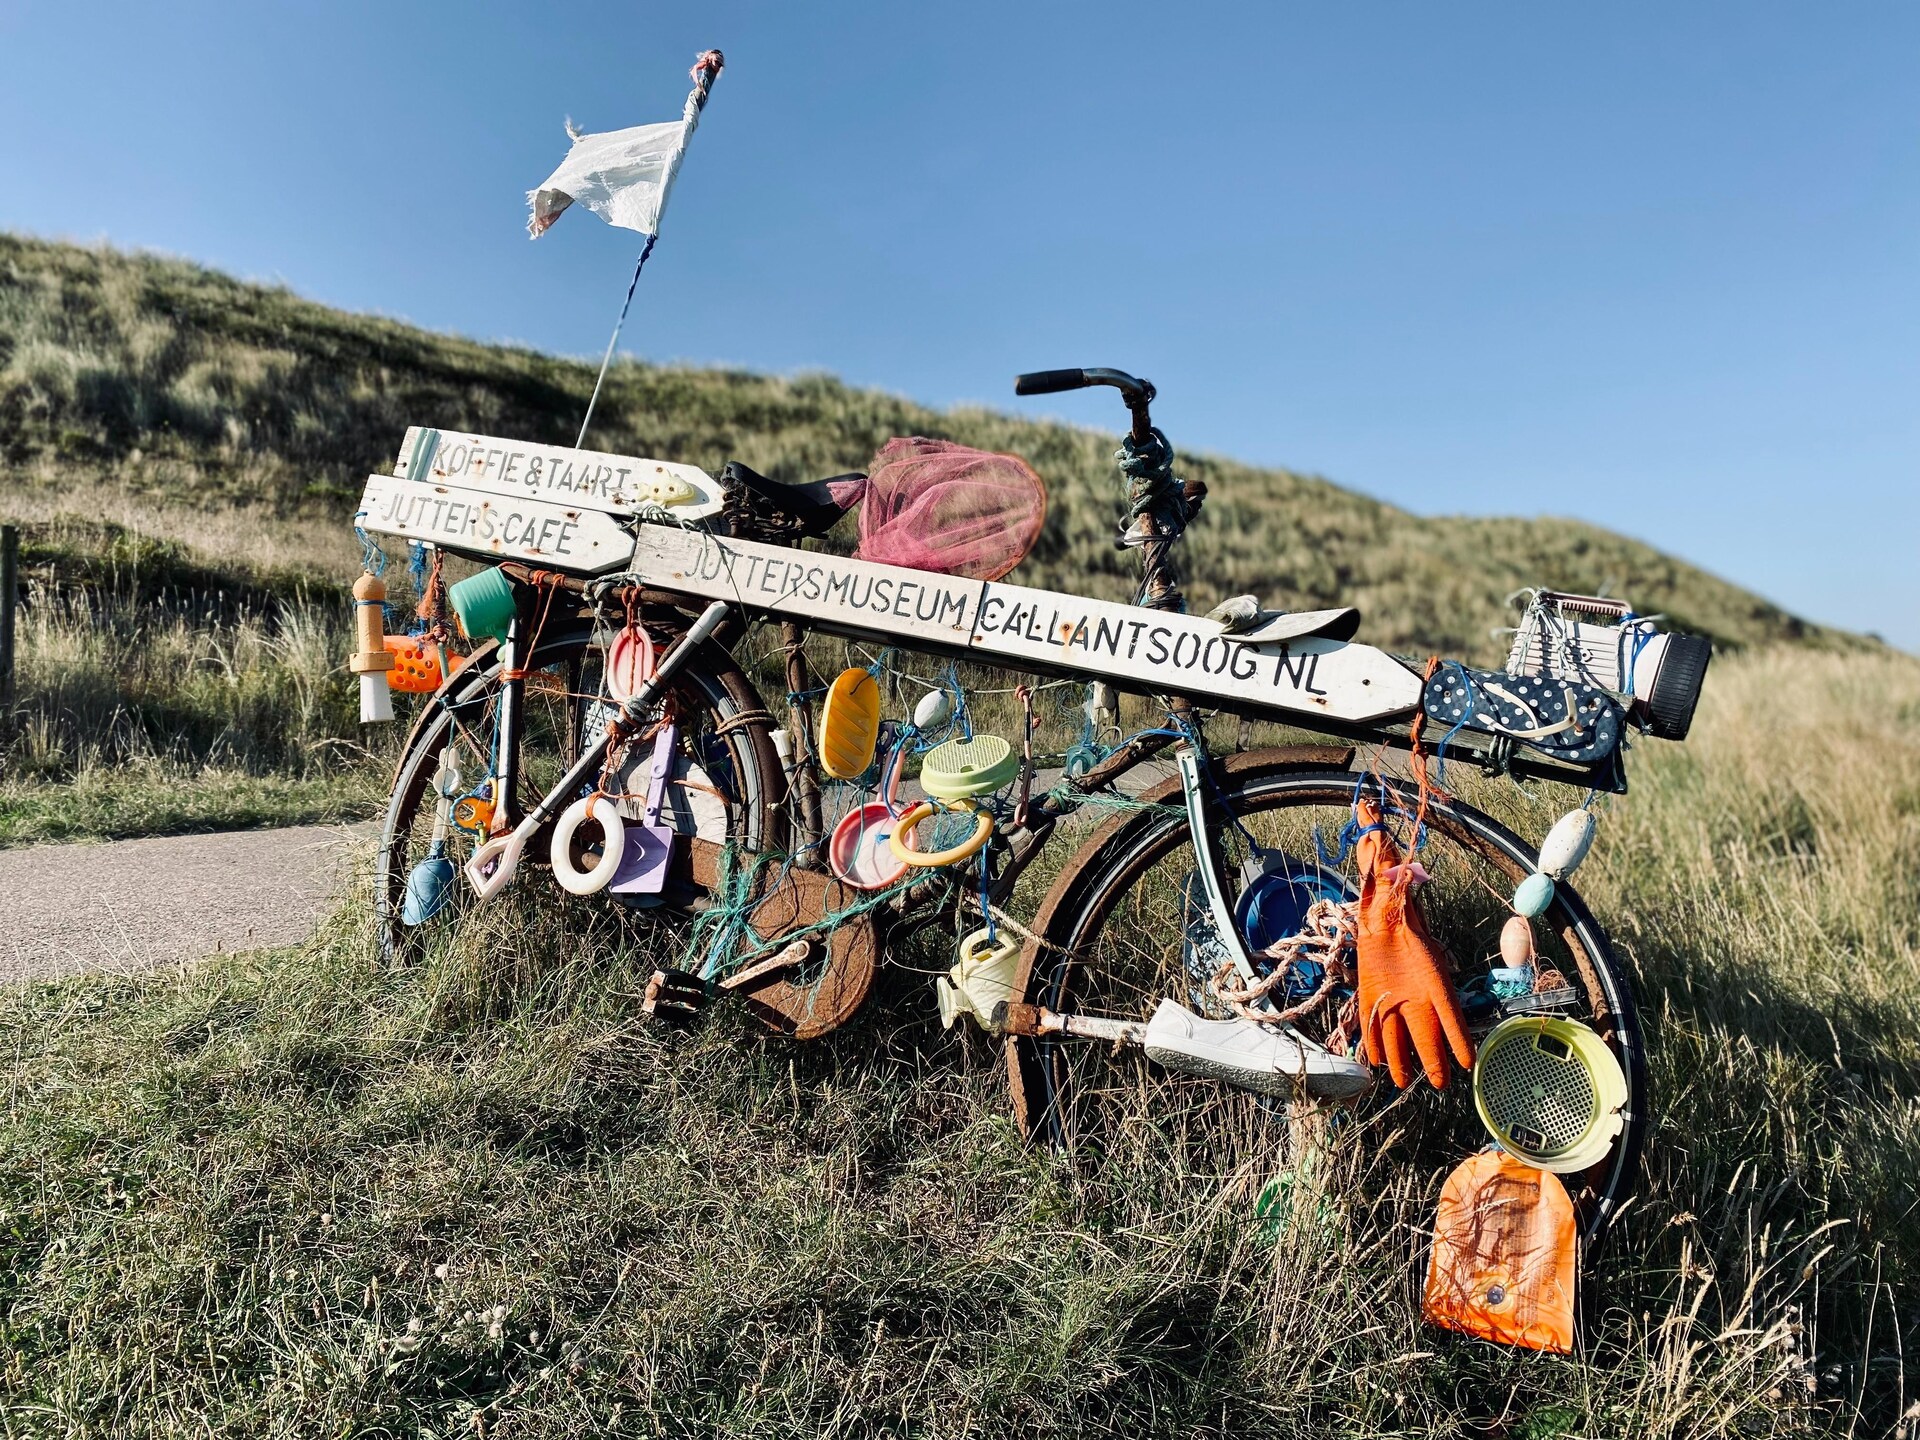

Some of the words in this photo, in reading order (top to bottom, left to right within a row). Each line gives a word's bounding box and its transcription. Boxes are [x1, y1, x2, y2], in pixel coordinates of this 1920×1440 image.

[433, 441, 524, 482] KOFFIE
[548, 458, 632, 497] TAART
[382, 493, 497, 539] JUTTERS
[684, 547, 968, 626] JUTTERSMUSEUM
[979, 597, 1260, 680] CALLANTSOOG
[1273, 647, 1327, 695] NL
